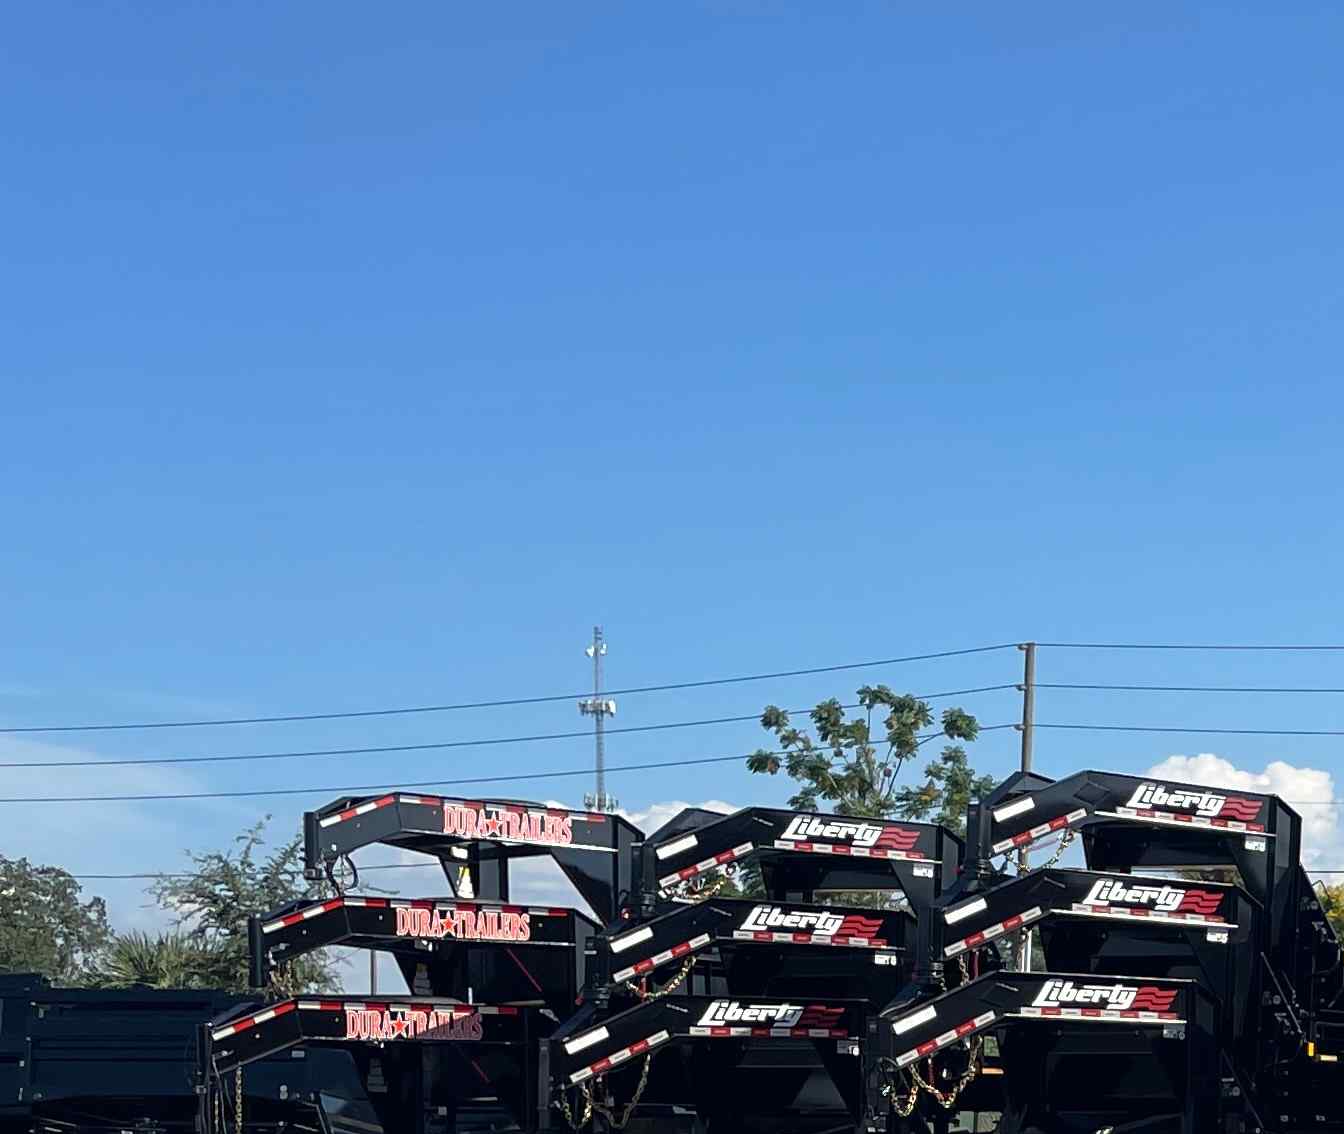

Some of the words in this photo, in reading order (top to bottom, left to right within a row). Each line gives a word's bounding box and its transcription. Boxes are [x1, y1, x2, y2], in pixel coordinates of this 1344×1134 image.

[1125, 782, 1226, 817] Liberty
[780, 814, 883, 847] Liberty
[1082, 878, 1186, 911] Liberty
[739, 904, 845, 936] Liberty
[1031, 978, 1138, 1010] Liberty
[697, 999, 804, 1028] Liberty
